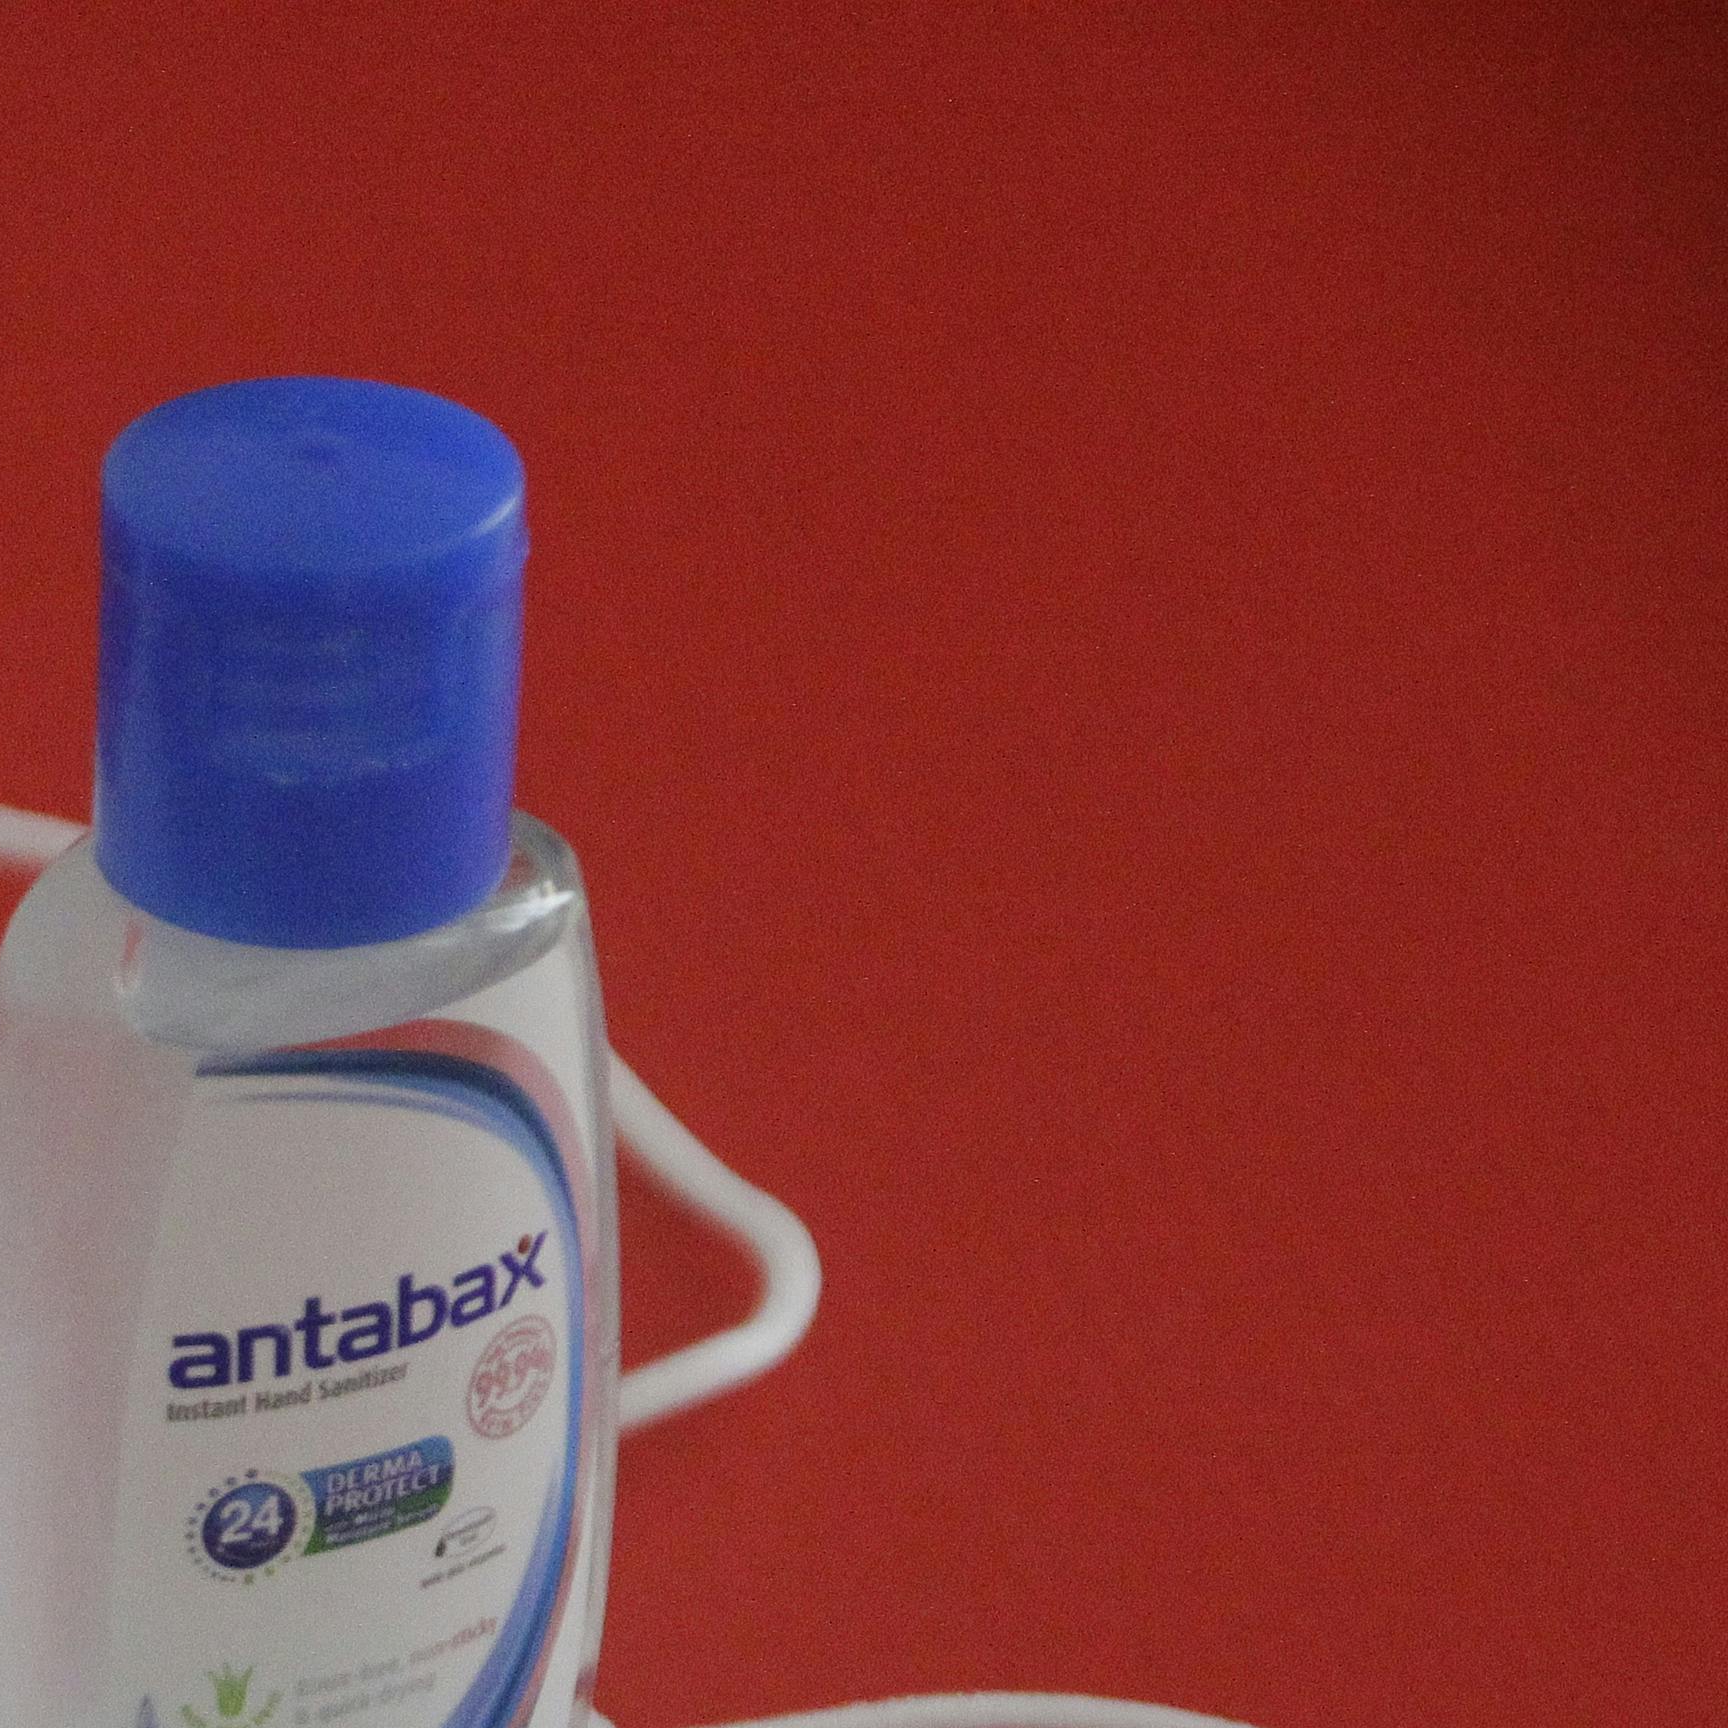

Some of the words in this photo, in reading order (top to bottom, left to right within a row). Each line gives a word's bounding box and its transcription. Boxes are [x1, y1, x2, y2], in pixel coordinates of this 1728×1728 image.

[167, 1230, 549, 1390] antabax
[166, 1394, 248, 1422] Instant
[255, 1380, 312, 1413] Hand
[318, 1362, 409, 1400] Sanitizer
[325, 1464, 442, 1517] PROTECT
[326, 1450, 425, 1494] DERMA
[219, 1493, 285, 1545] 24
